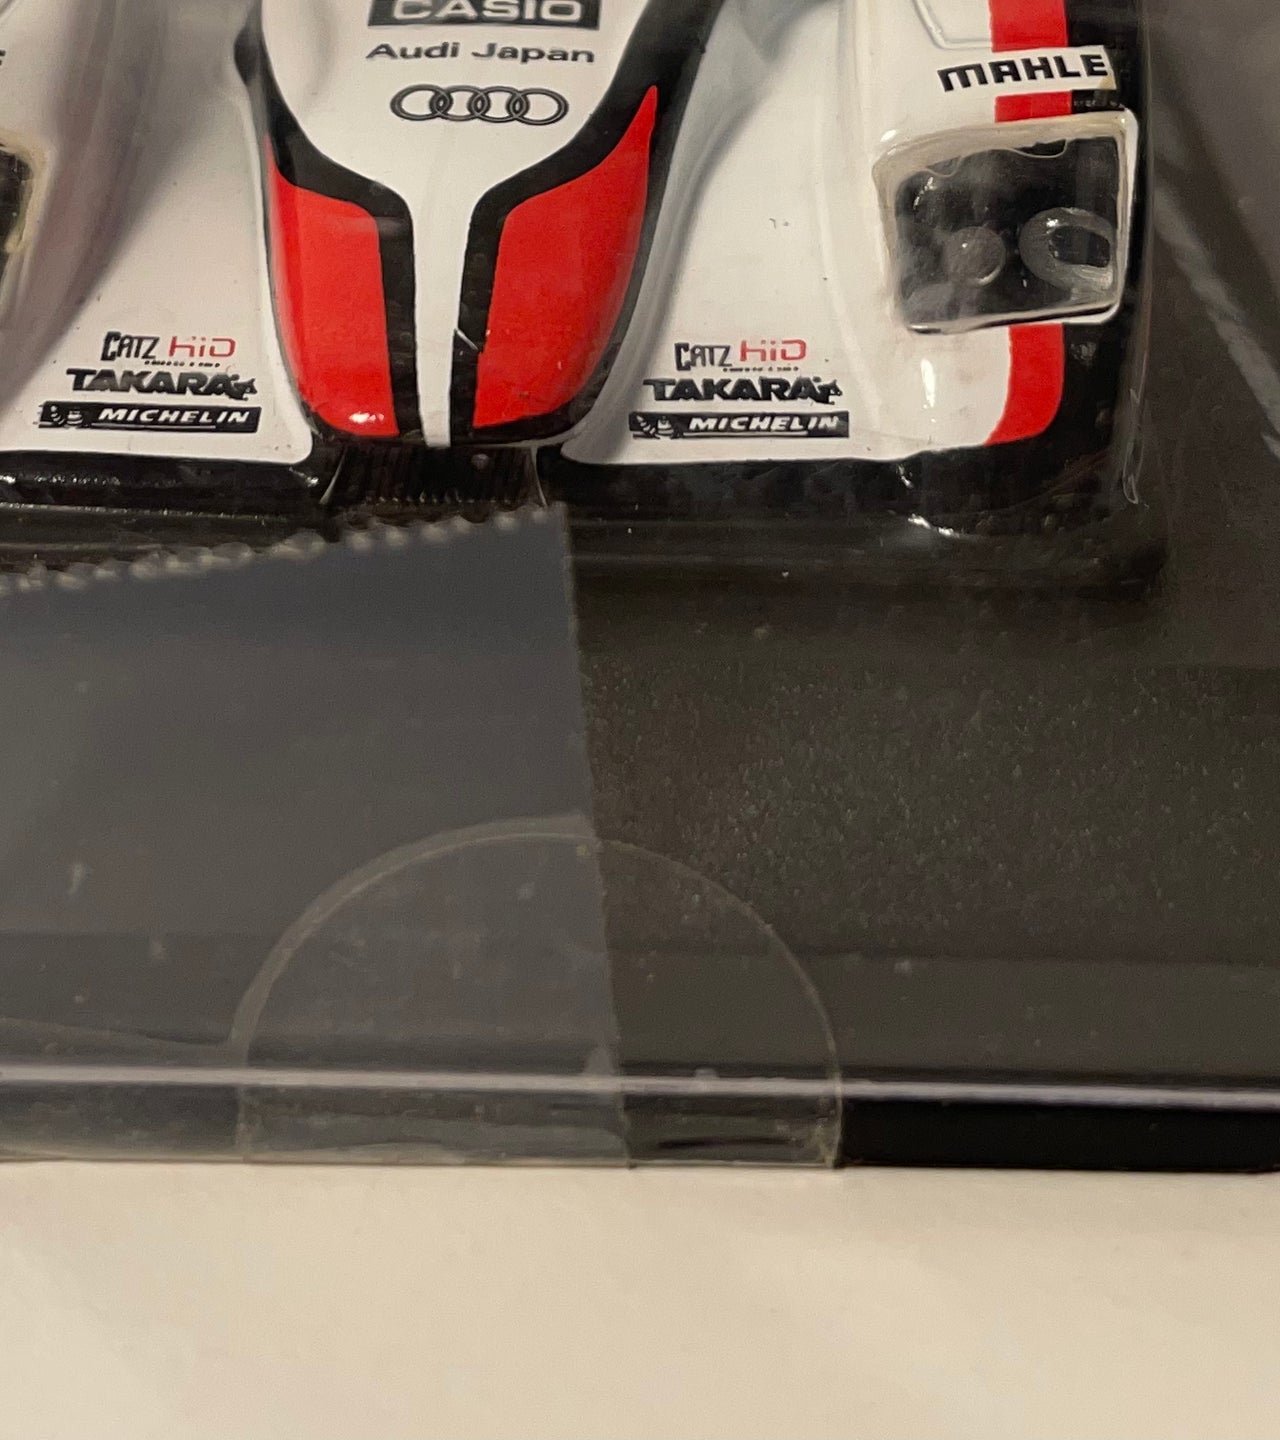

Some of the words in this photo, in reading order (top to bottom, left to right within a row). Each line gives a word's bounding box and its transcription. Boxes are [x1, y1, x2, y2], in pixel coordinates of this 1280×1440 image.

[365, 41, 461, 60] Audi
[471, 42, 596, 64] Japan
[936, 53, 1109, 93] MAHLE
[100, 331, 161, 362] CATZ
[674, 342, 733, 372] CATZ
[66, 368, 237, 397] TAKARA
[642, 376, 818, 403] TAKARA
[97, 407, 251, 425] MICHELIN
[687, 415, 841, 432] MICHELIN
